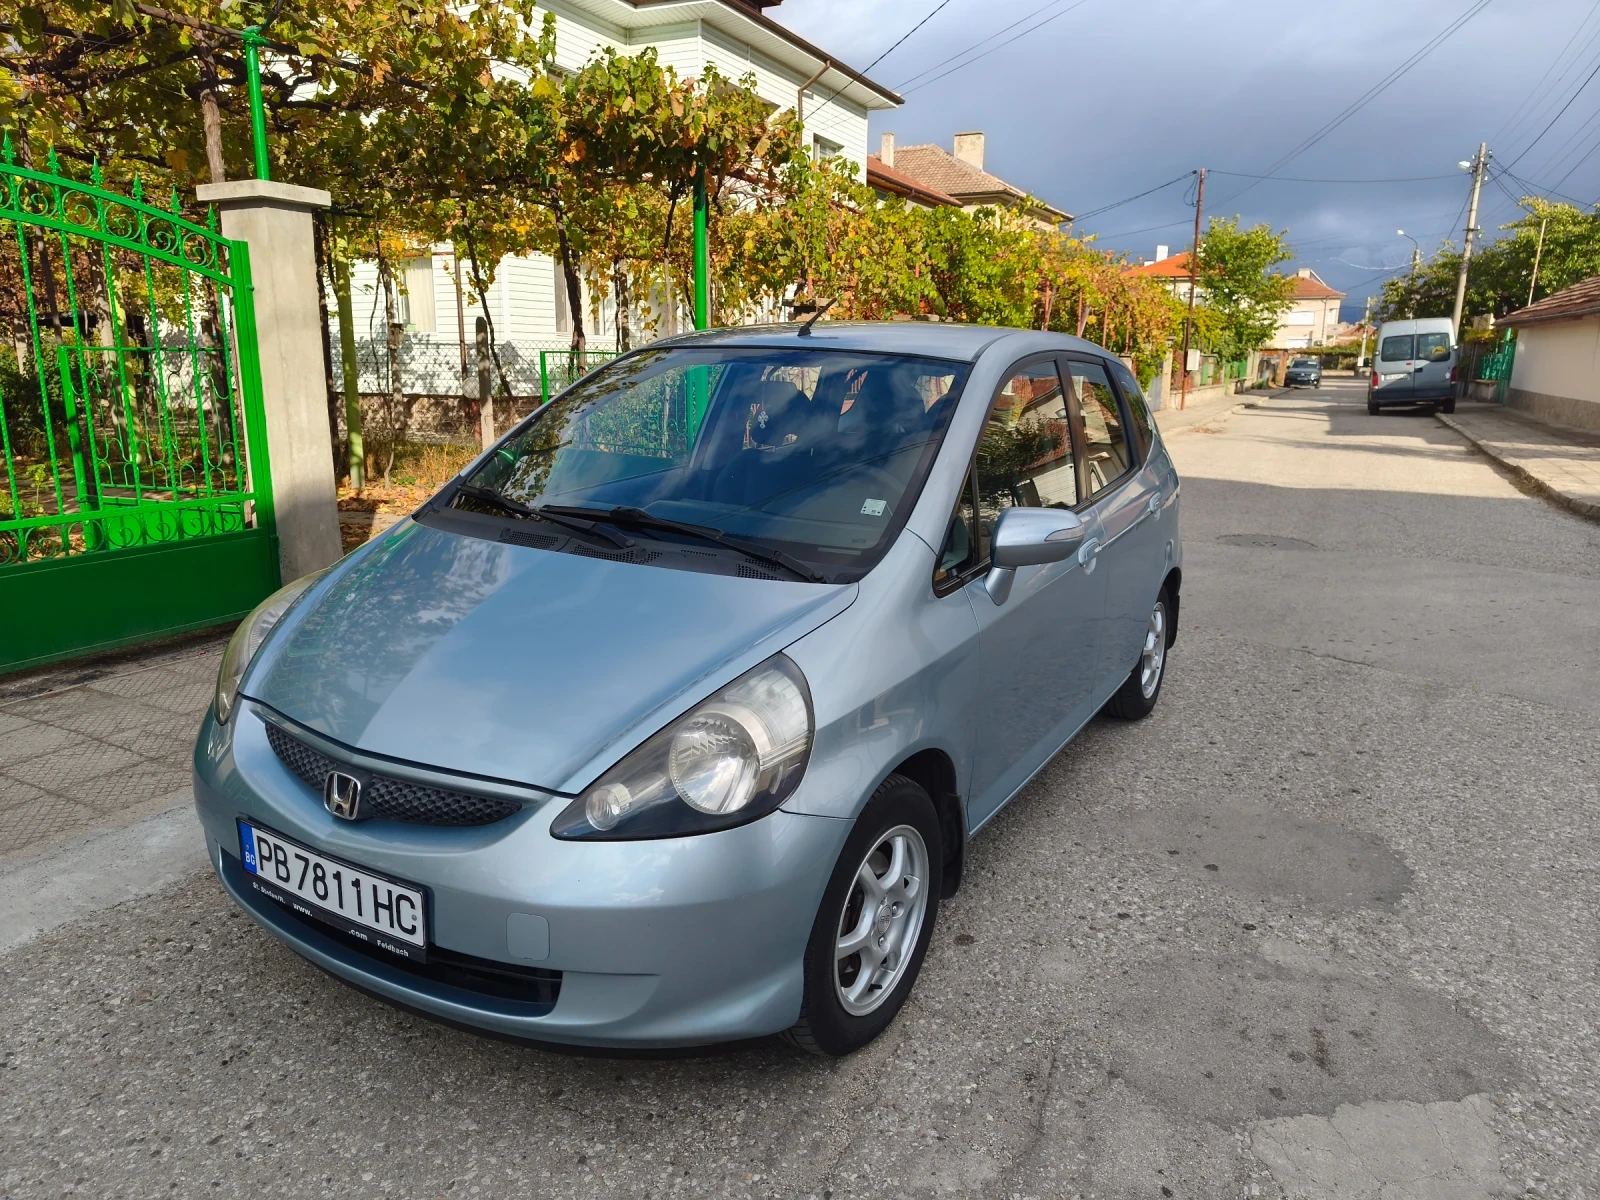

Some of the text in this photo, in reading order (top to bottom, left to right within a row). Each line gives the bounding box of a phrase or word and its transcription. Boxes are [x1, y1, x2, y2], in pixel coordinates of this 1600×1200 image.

[245, 851, 256, 865] BG
[256, 834, 417, 936] PB7811HC
[376, 939, 409, 957] Feldbach
